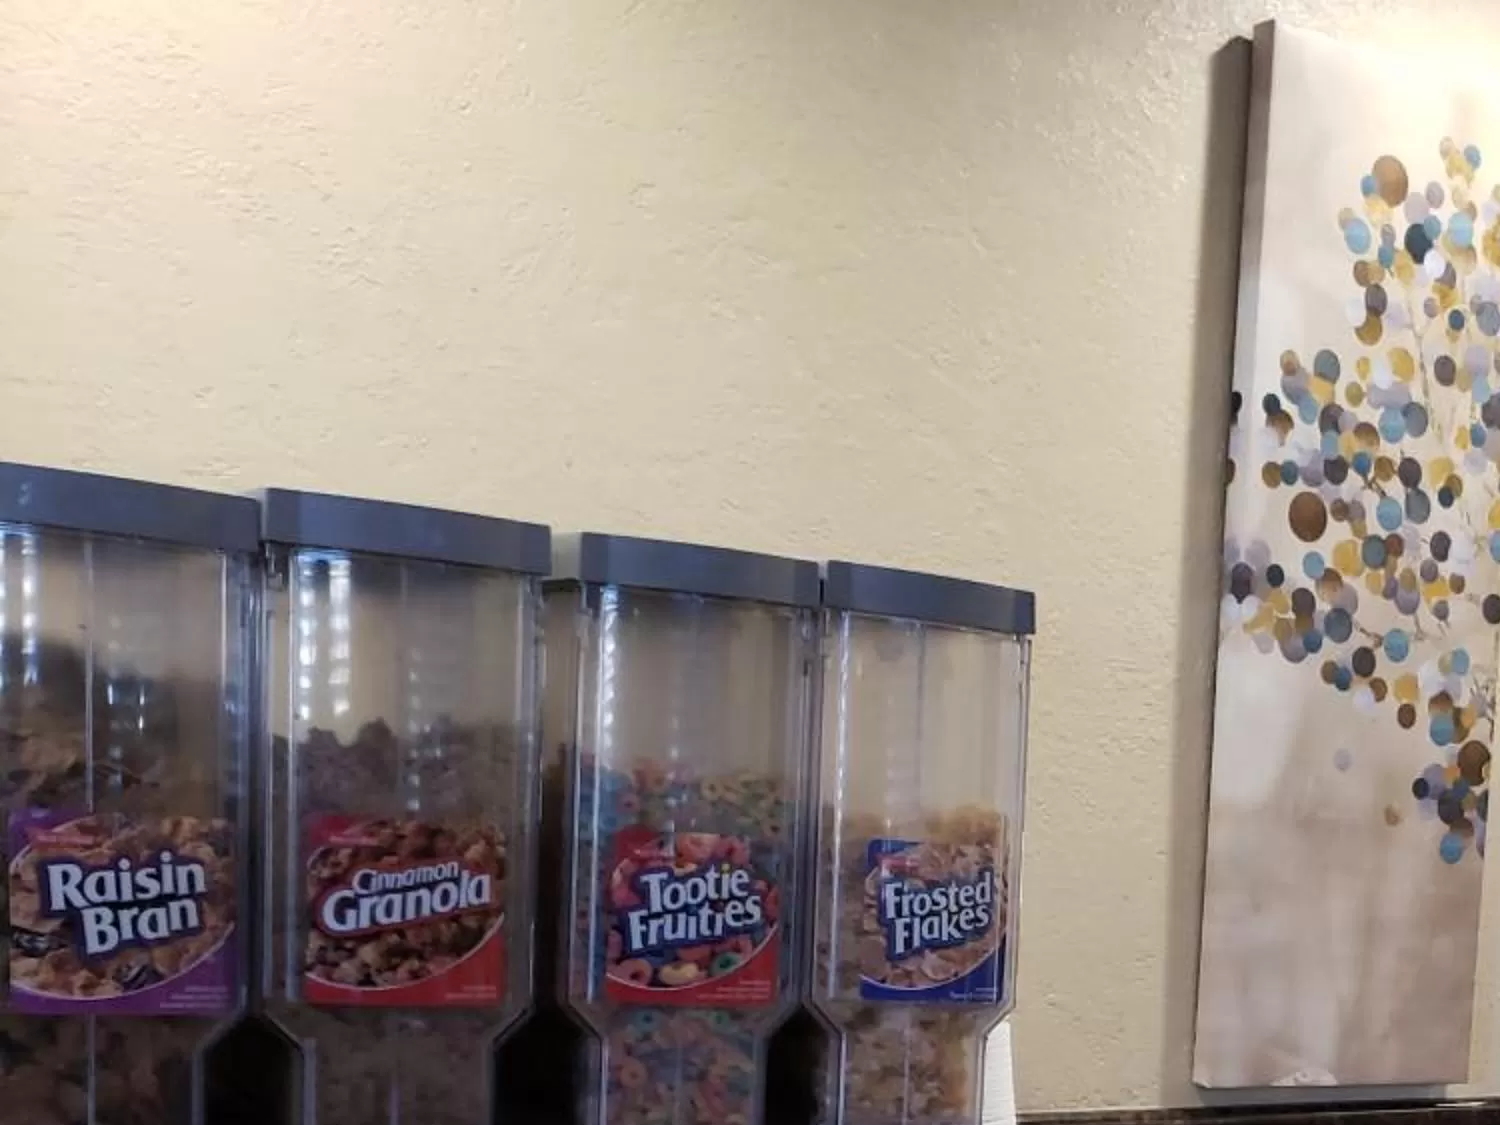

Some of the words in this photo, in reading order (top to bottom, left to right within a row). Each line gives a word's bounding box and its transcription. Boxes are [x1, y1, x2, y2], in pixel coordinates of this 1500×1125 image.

[47, 850, 208, 911] Raisin
[322, 870, 492, 932] Granola
[352, 861, 459, 895] Cinnamon
[640, 863, 751, 914] Tootie
[884, 871, 992, 919] Frosted
[81, 898, 200, 955] Bran
[627, 895, 762, 951] Fruities
[894, 904, 991, 955] Flakes
